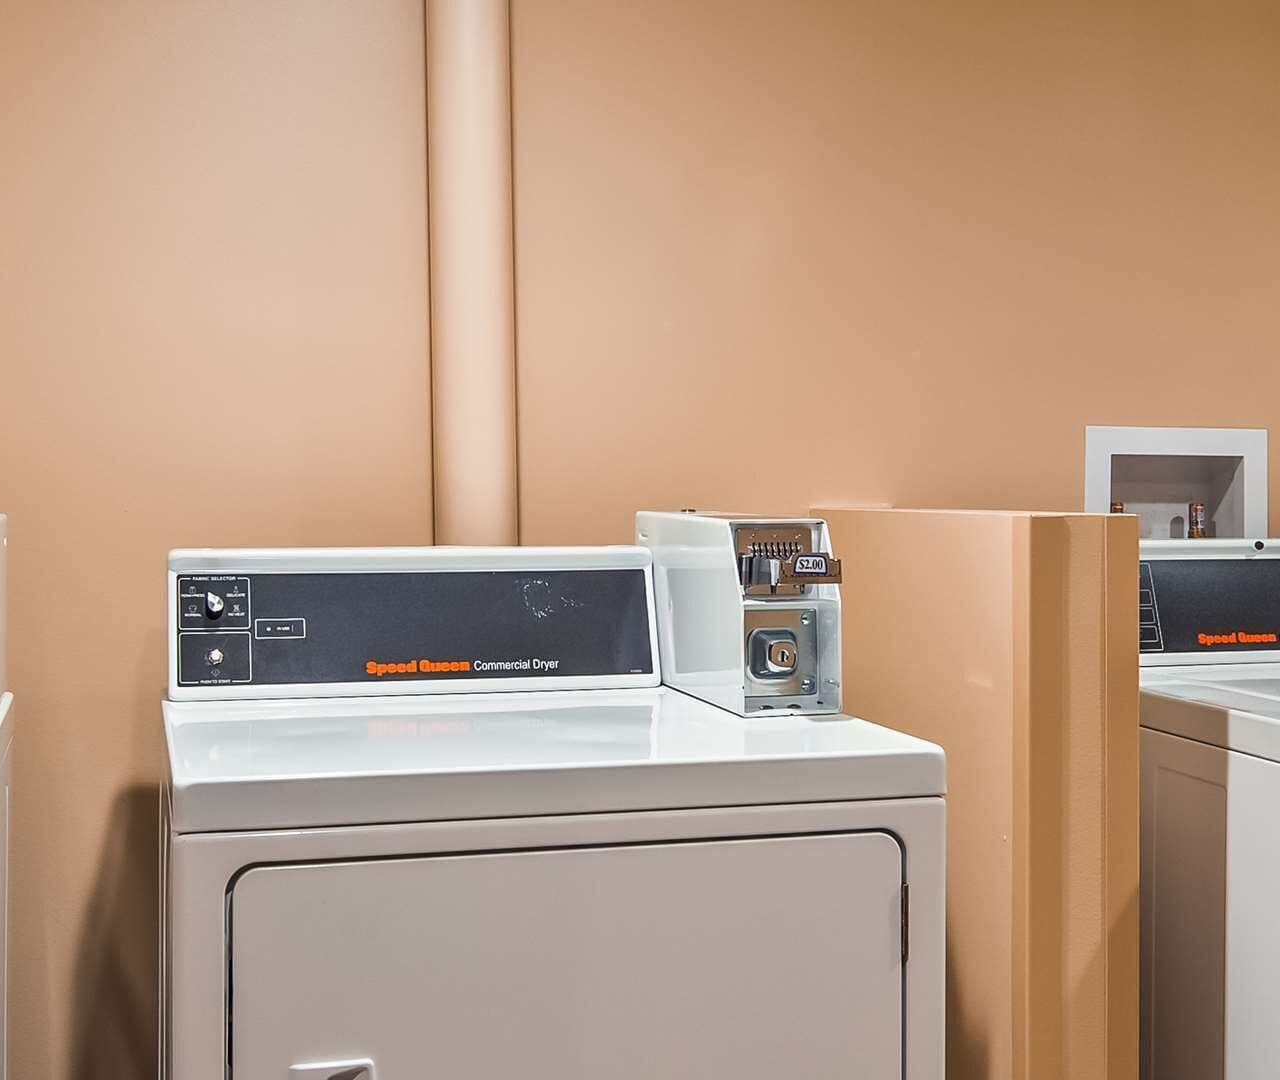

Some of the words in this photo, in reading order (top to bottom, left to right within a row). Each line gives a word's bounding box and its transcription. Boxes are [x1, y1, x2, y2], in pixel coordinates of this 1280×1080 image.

[799, 559, 823, 570] $2.00
[1198, 632, 1237, 645] Speed
[1238, 631, 1277, 643] Queen
[366, 660, 418, 676] Speed
[420, 659, 470, 673] Queen
[473, 660, 531, 671] Commercial
[533, 658, 560, 672] Dryer
